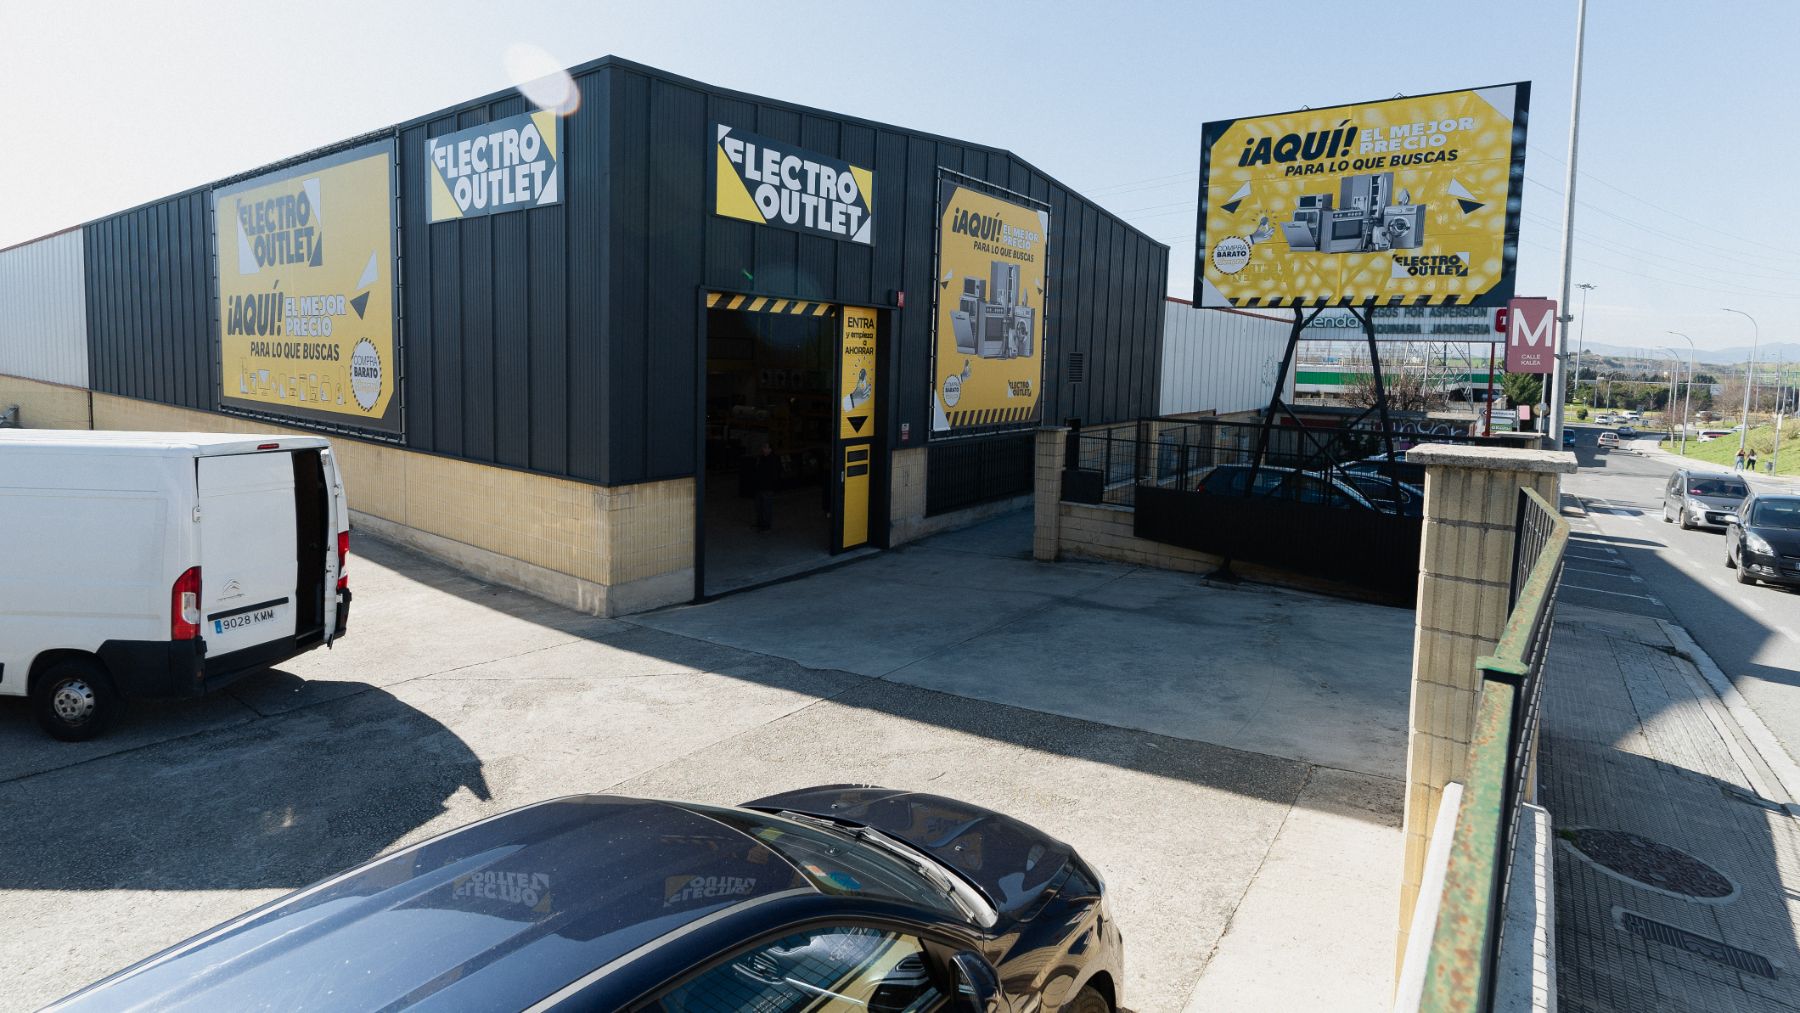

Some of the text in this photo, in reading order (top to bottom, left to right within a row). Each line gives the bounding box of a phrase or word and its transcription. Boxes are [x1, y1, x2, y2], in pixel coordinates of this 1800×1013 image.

[1360, 117, 1474, 143] EL MEJOR
[434, 123, 541, 179] ELECTRO
[1238, 119, 1358, 167] ¡AQUÍ!
[1359, 133, 1447, 154] PRECIO
[724, 136, 858, 205] ELECTRO
[1285, 149, 1458, 176] PARA LO QUE BUSCAS
[454, 160, 546, 212] OUTLET
[237, 190, 311, 236] ELECTRO
[755, 183, 862, 236] OUTLET
[952, 207, 1003, 243] ¡AQUÍ!
[1003, 224, 1040, 243] EL MEJOR
[254, 226, 315, 268] OUTLET
[973, 240, 1034, 263] PARA LO QUE BUSCAS
[1003, 235, 1031, 250] PRECIO
[1216, 250, 1247, 258] BARATO
[1394, 254, 1461, 267] ELECTRO
[1407, 265, 1463, 276] OUTLET
[227, 279, 284, 336] ¡AQUÍ!
[285, 294, 347, 317] EL MEJOR
[1404, 307, 1425, 318] POR
[285, 316, 333, 337] PRECIO
[847, 316, 875, 329] ENTRA
[1511, 308, 1554, 347] M
[250, 341, 340, 362] PARA LO QUE BUSCAS
[845, 346, 874, 355] AHORRAR
[354, 366, 379, 379] BARATO
[223, 609, 275, 630] 9028 KMM
